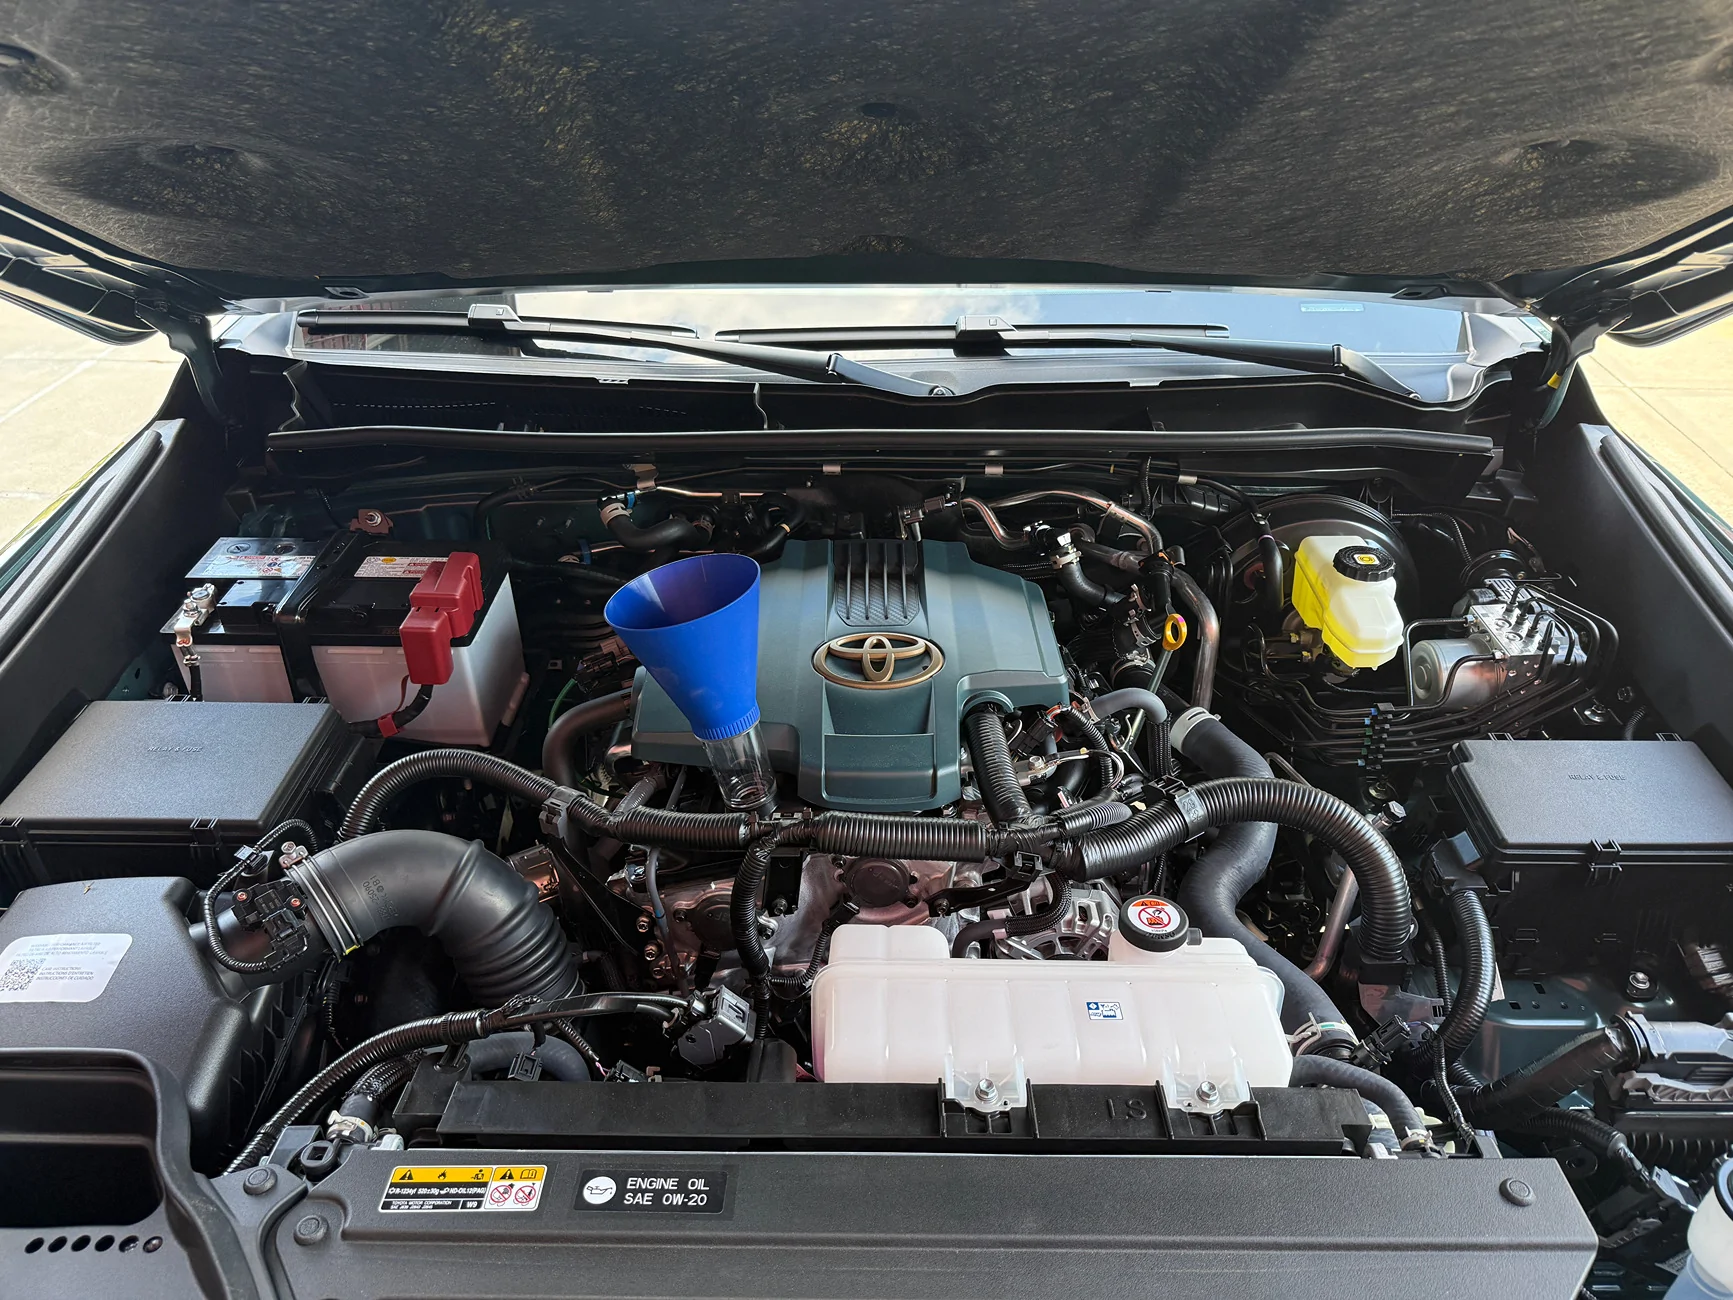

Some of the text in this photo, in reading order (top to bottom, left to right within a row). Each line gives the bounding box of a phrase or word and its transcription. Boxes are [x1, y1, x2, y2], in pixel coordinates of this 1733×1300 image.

[626, 1177, 710, 1190] ENGINE OIL
[623, 1192, 708, 1206] SAE 0W-20
